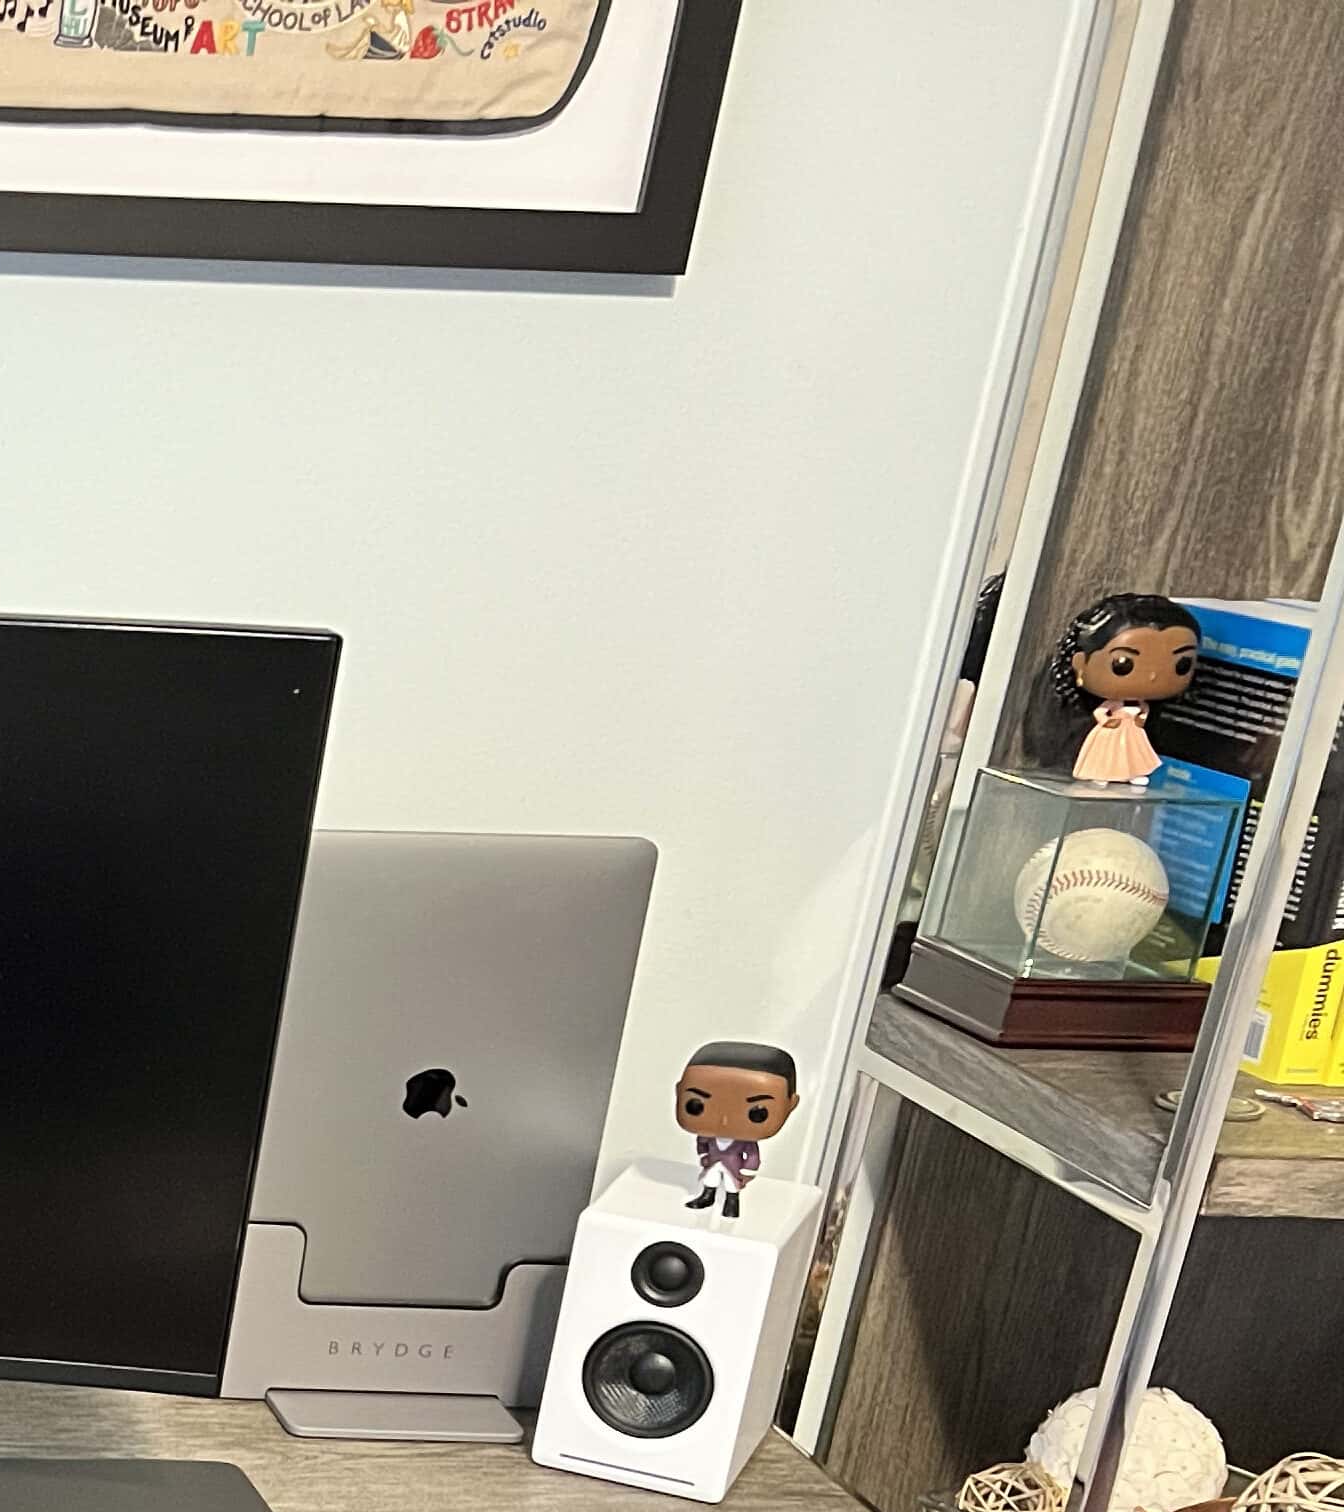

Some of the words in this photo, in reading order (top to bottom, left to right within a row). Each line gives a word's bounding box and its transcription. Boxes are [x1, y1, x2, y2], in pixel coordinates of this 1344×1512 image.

[100, 0, 180, 53] USEUM
[190, 20, 265, 57] ART
[241, 0, 311, 31] CHOOL
[445, 0, 516, 33] STRA
[1305, 949, 1342, 1040] dummies
[328, 1340, 457, 1360] BRYDGE
